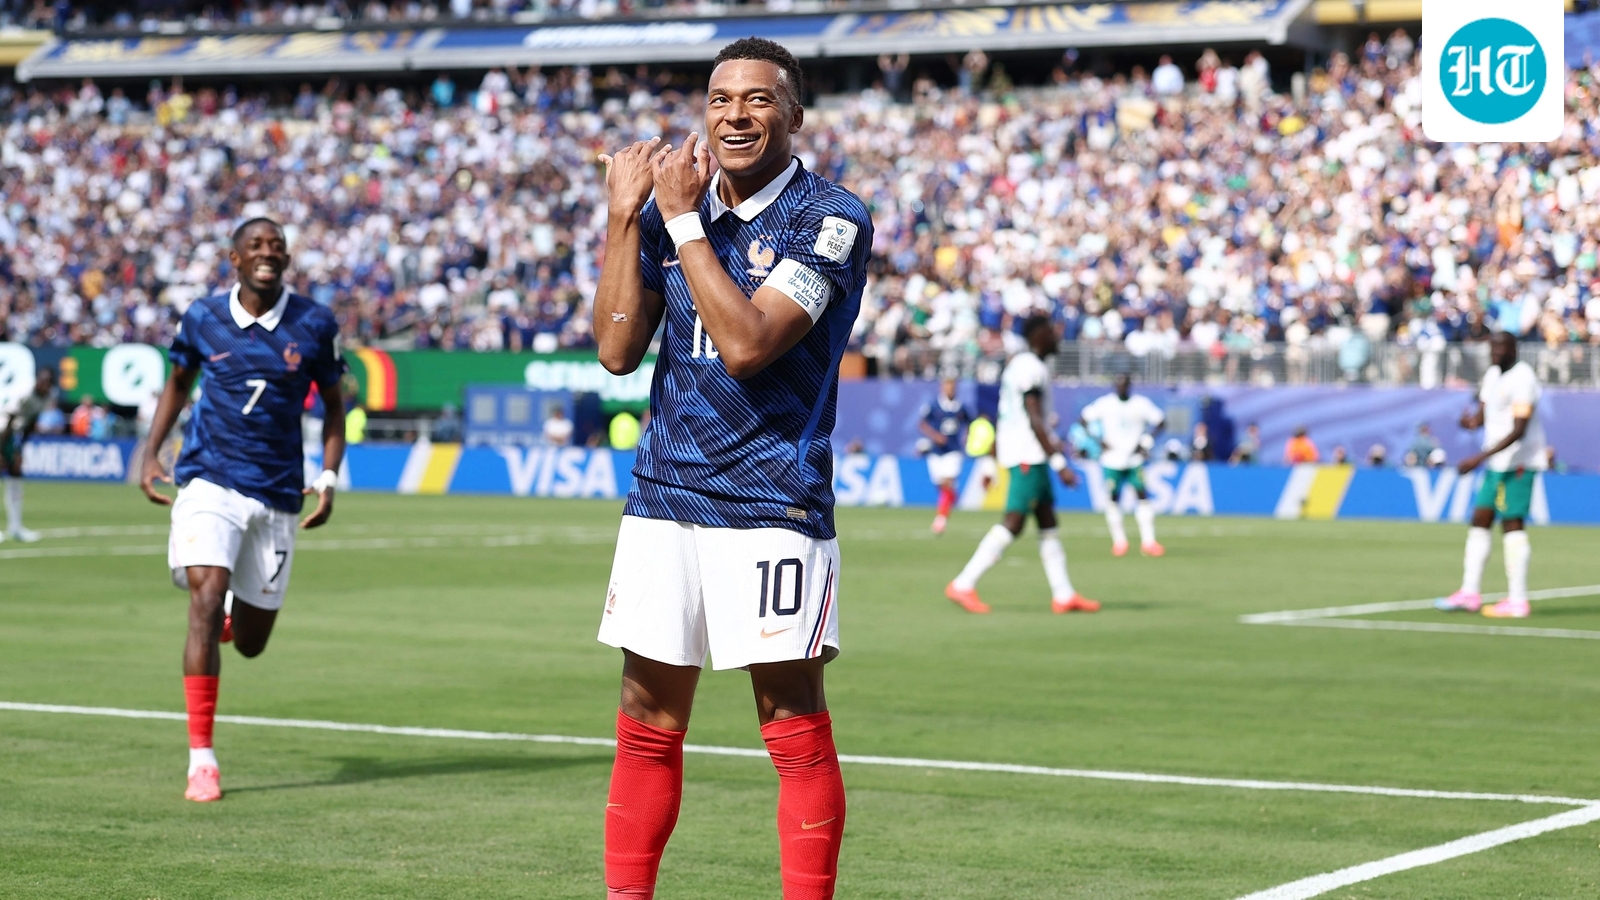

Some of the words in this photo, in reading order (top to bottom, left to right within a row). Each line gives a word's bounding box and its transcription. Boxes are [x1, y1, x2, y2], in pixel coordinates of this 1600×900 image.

[827, 240, 844, 253] PEACE
[788, 277, 801, 289] the
[801, 286, 823, 309] World
[794, 268, 826, 299] UNITES
[242, 379, 267, 415] 7
[20, 441, 125, 478] MERICA
[496, 446, 617, 498] VISA
[271, 551, 287, 583] 7
[756, 558, 804, 618] 10
